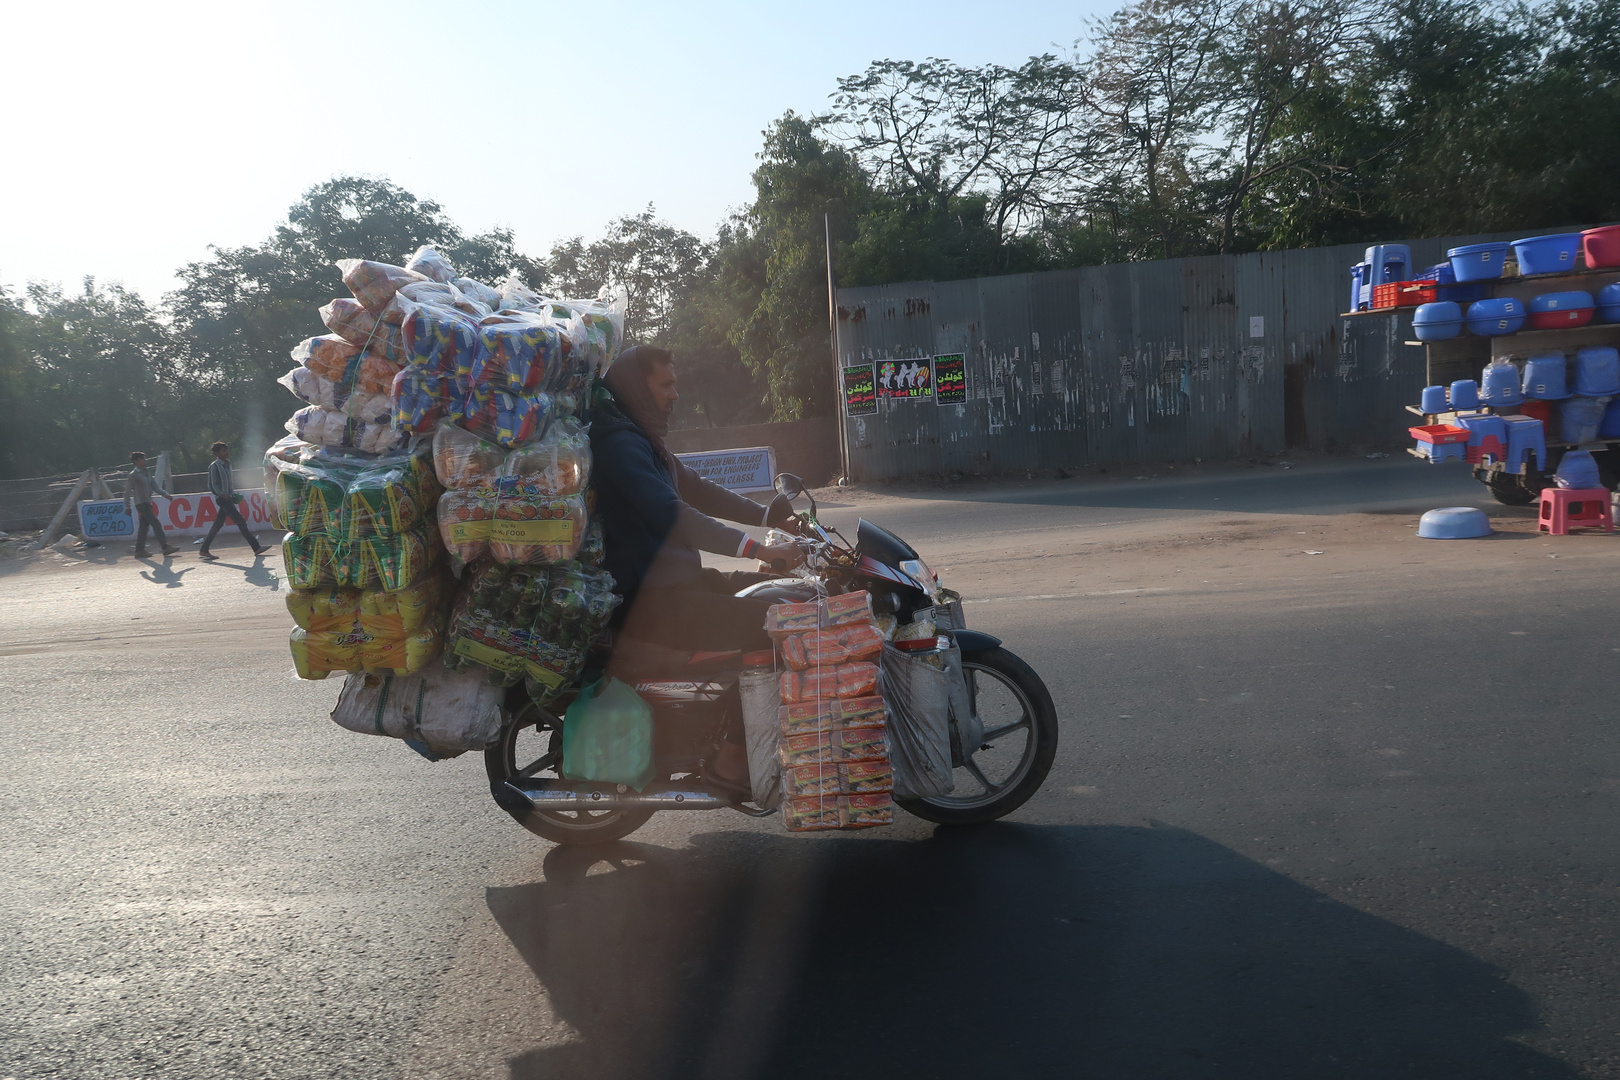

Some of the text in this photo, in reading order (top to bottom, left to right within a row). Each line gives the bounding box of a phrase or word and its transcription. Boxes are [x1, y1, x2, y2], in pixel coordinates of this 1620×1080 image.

[737, 454, 763, 464] PROJECT
[710, 467, 723, 475] FOR
[723, 463, 760, 475] ENGINEERS
[727, 472, 755, 484] CLASSE
